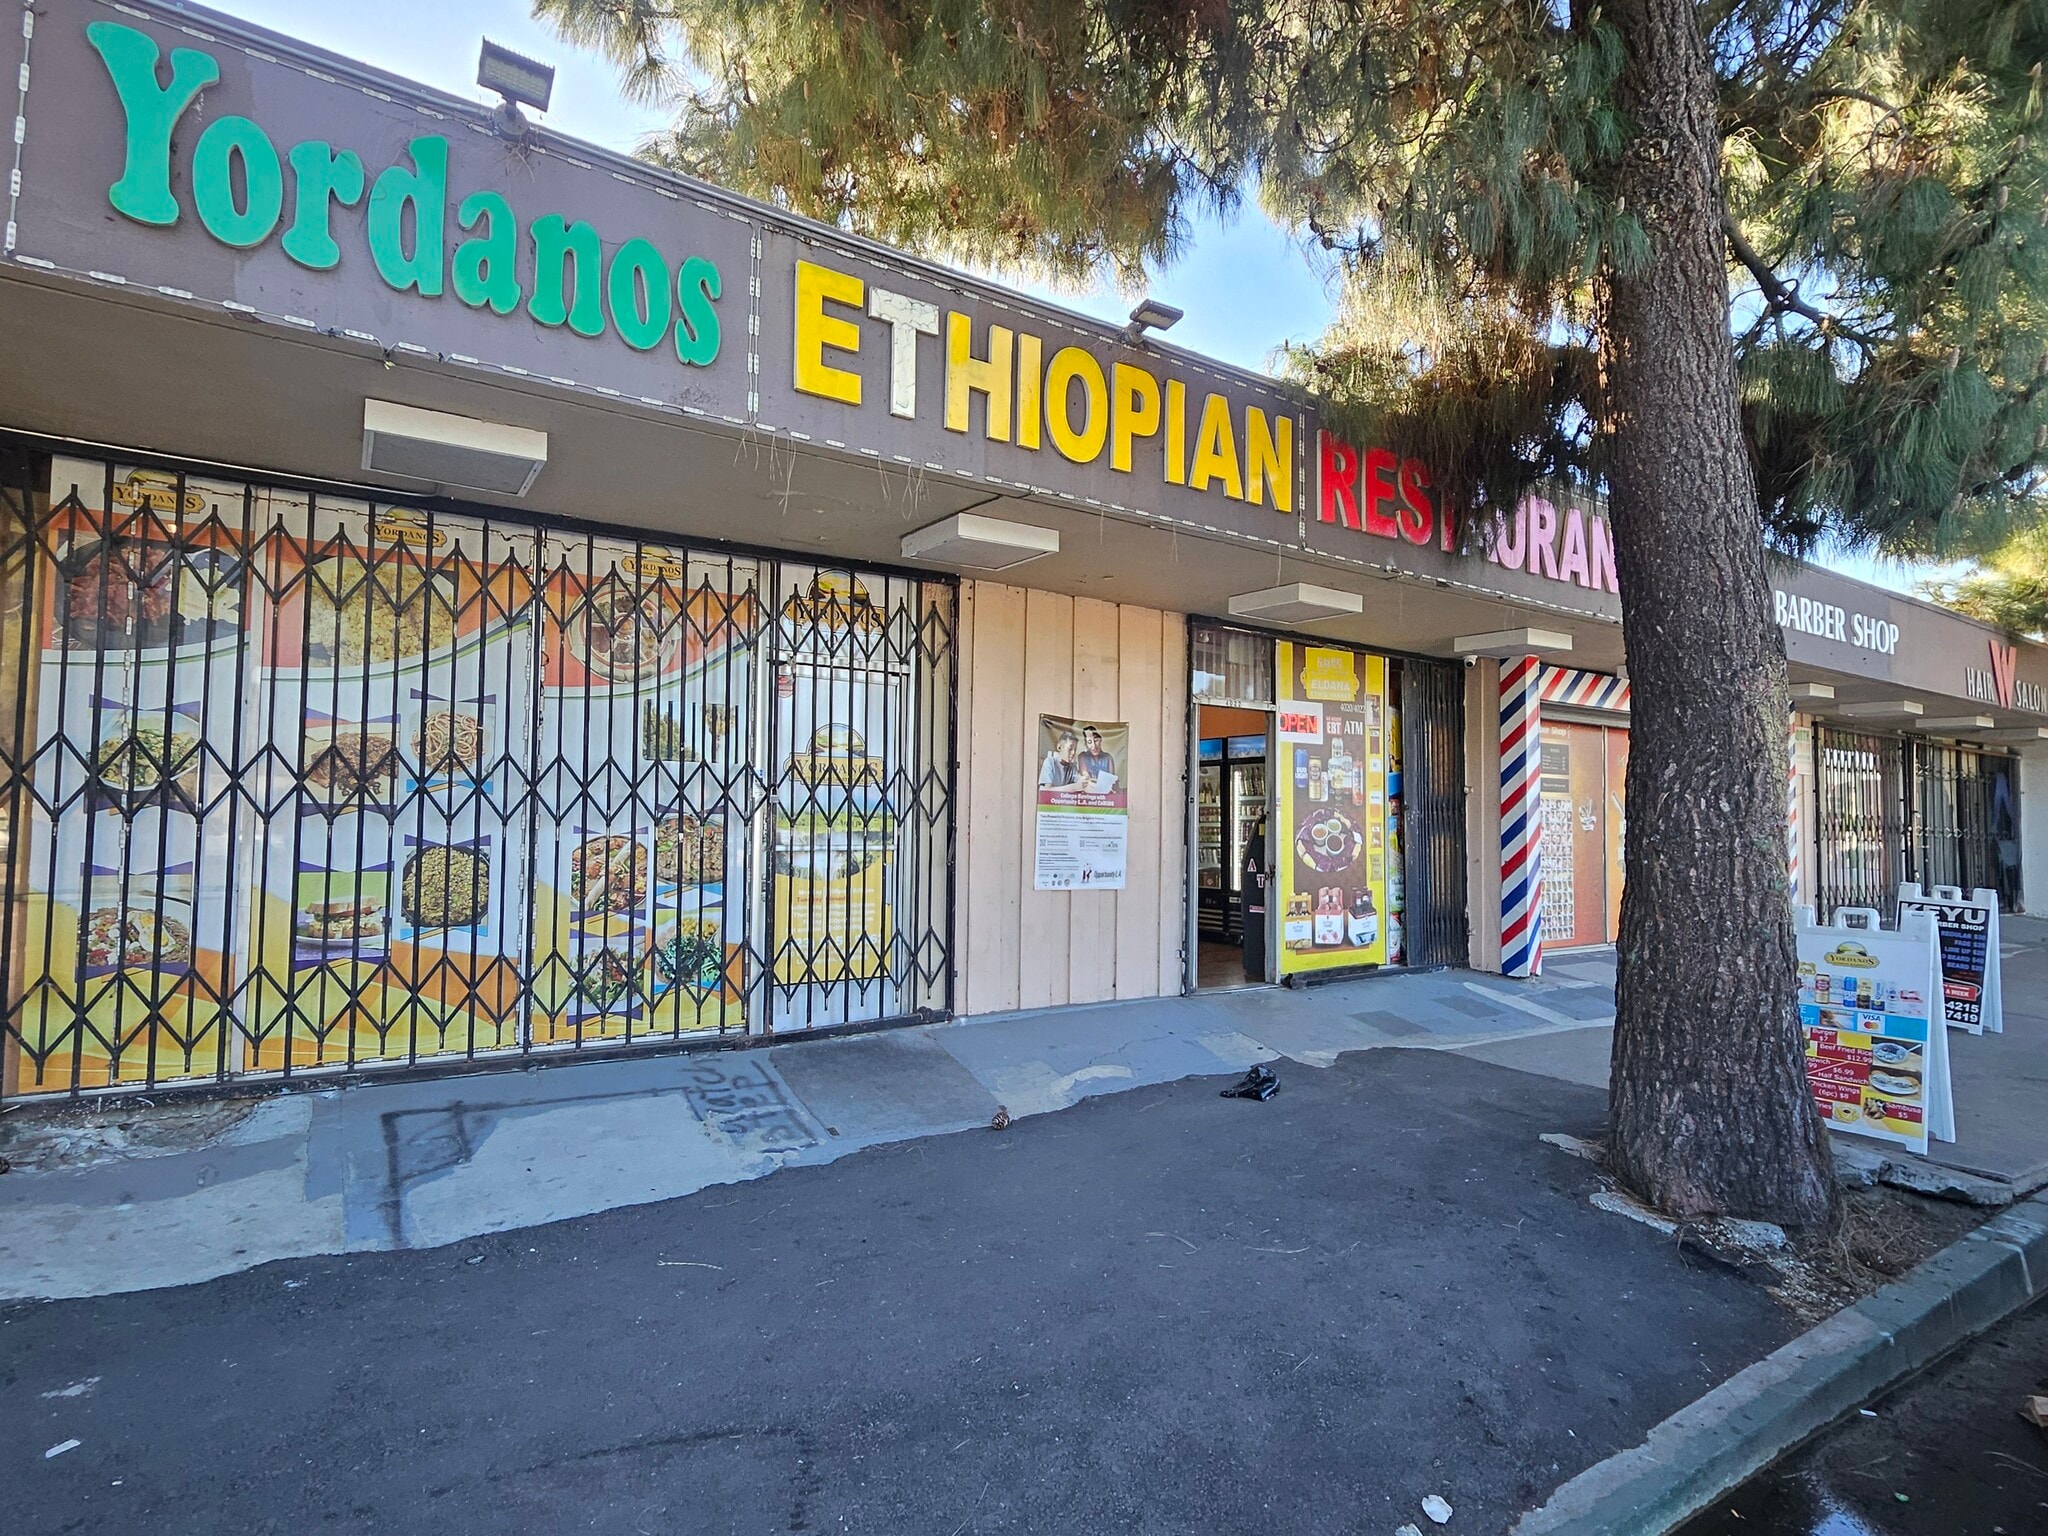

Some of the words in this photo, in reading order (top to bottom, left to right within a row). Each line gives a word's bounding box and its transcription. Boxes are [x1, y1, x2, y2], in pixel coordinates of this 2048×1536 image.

[87, 21, 722, 368] Yordanos
[793, 259, 1294, 513] ETHIOPIAN
[1775, 589, 1847, 643] BARBER
[1852, 612, 1900, 655] SHOP
[1966, 667, 1995, 701] HAIR
[1989, 639, 2017, 710] W
[2016, 679, 2047, 713] SALON
[1280, 713, 1318, 734] OPEN
[1326, 721, 1342, 735] EBT
[1344, 720, 1364, 736] ATM
[1961, 923, 1985, 932] SHOP
[1862, 1013, 1882, 1021] VISA
[1812, 1027, 1837, 1037] Burger
[1820, 1042, 1836, 1051] Beef
[1837, 1045, 1856, 1054] Fried
[1847, 1054, 1873, 1064] $12.99
[1833, 1066, 1855, 1076] $6.99
[1818, 1071, 1833, 1079] Half
[1834, 1073, 1869, 1086] Sandwich
[1818, 1088, 1838, 1098] (6pc)
[1838, 1085, 1860, 1095] Wings
[1886, 1102, 1922, 1114] Sambusa
[1898, 1111, 1908, 1119] $5
